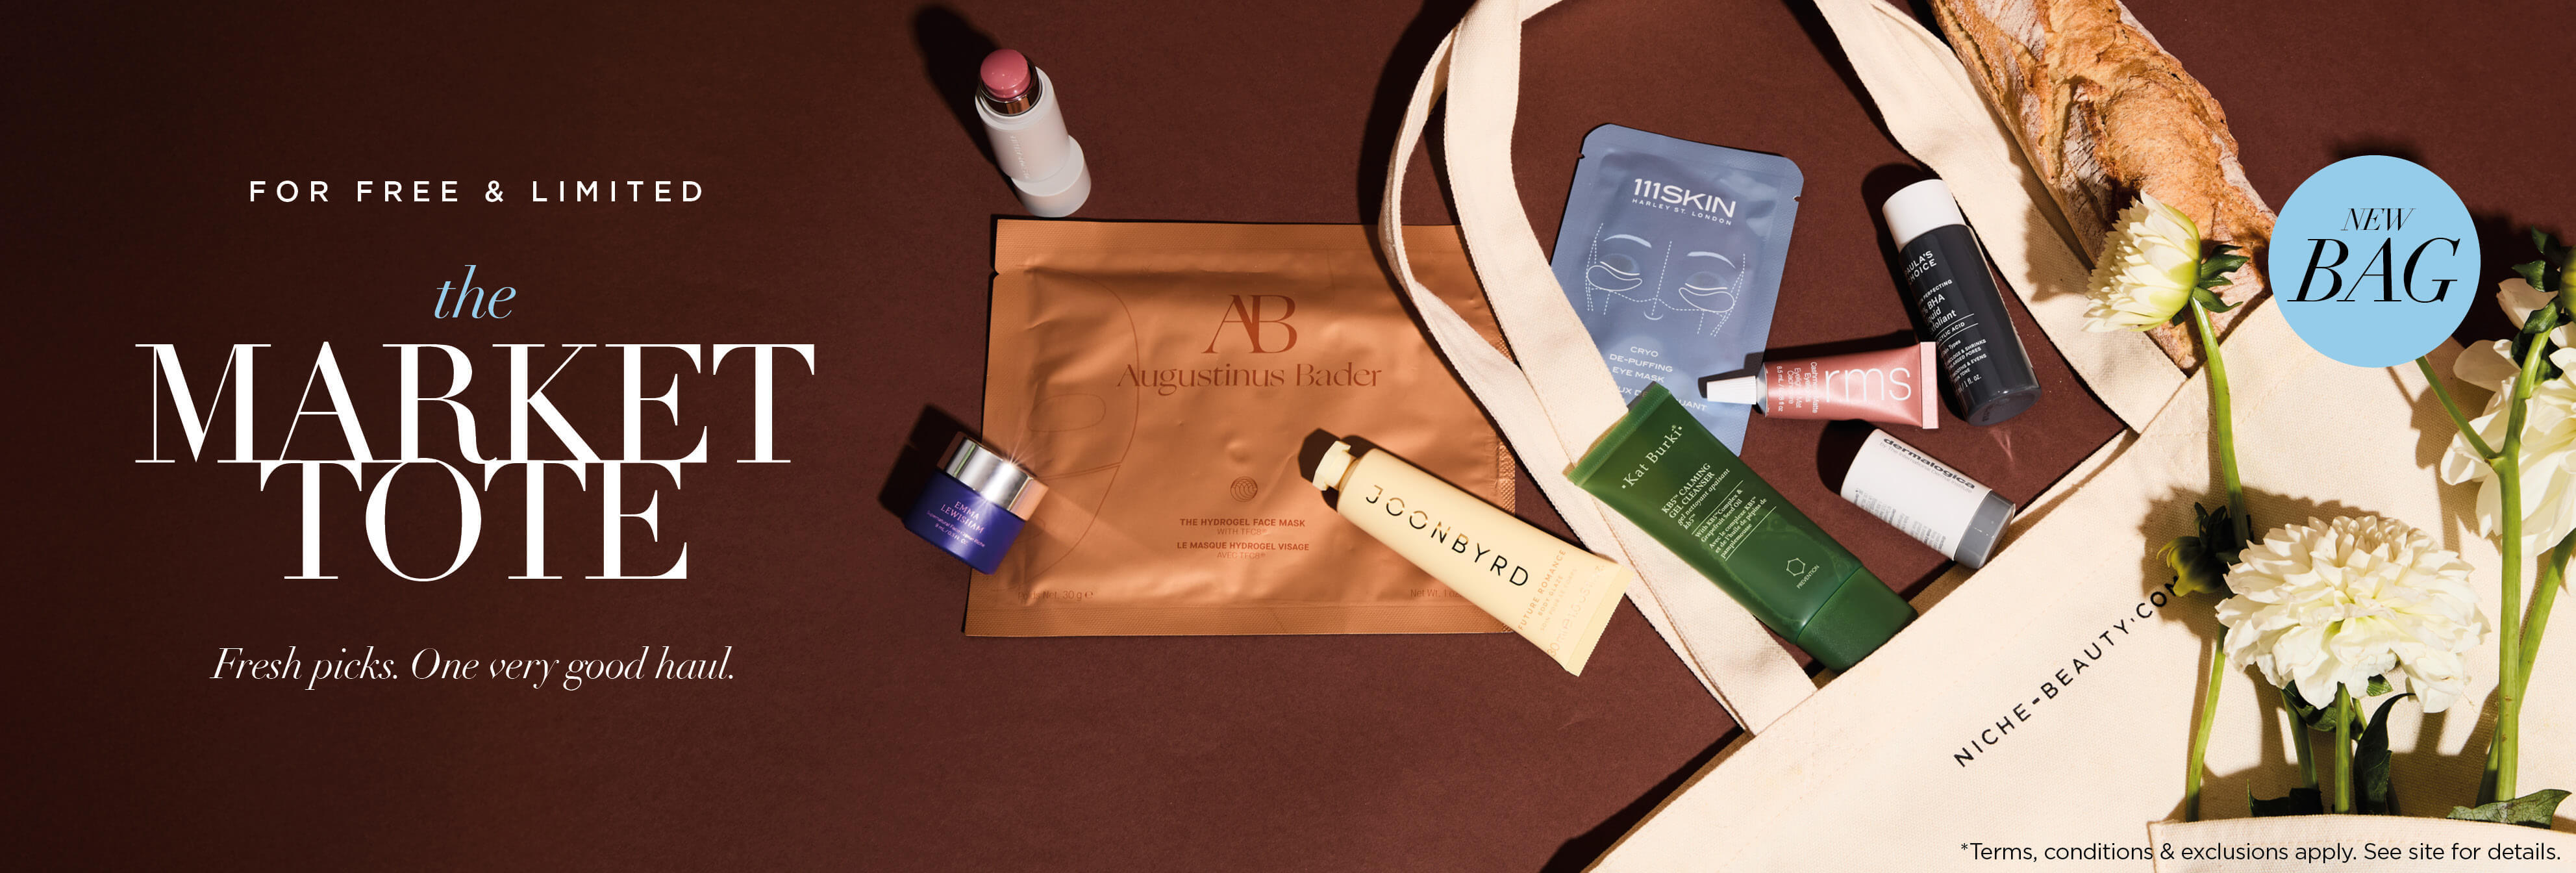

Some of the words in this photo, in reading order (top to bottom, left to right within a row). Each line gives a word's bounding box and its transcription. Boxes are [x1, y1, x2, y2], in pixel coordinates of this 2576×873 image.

[1632, 177, 1735, 217] 111SKIN
[1632, 198, 1669, 210] HARLEY
[1691, 212, 1731, 224] LONDON
[1923, 279, 1952, 299] PERFECTING
[1927, 293, 1944, 309] BHA
[1201, 294, 1298, 355] AB
[1929, 309, 1956, 333] xfoliant
[1952, 322, 1965, 331] ACID
[1630, 346, 1658, 357] CRYO
[1949, 340, 1960, 349] Types
[1964, 338, 1986, 351] SHRINKS
[1966, 346, 1981, 357] PORES
[1610, 353, 1673, 372] DE-PUFFING
[1971, 353, 1987, 363] EVENS
[1116, 362, 1285, 396] Augustinus
[1296, 361, 1382, 387] Bader
[1612, 367, 1632, 375] EYE
[1634, 372, 1664, 383] MASK
[1960, 368, 1970, 376] TONE
[1825, 367, 1912, 403] rms
[1883, 438, 1974, 488] dermalogica
[1678, 462, 1710, 496] CALMING
[1668, 503, 1683, 518] GEL
[1681, 471, 1714, 505] CLEANSER
[1676, 514, 1688, 525] gel
[1685, 490, 1708, 516] nettoyant
[1707, 468, 1730, 493] apaisant
[940, 504, 984, 533] LEWISHAM
[955, 501, 979, 519] EMMA
[1700, 517, 1725, 543] Grapefruit
[1722, 506, 1734, 519] Seed
[1732, 498, 1742, 508] Oil
[1718, 538, 1727, 547] de
[1759, 496, 1768, 505] de
[1179, 518, 1198, 526] THE
[1200, 518, 1250, 526] HYDROGEL
[1253, 518, 1276, 527] FACE
[1278, 518, 1306, 527] MASK
[1695, 524, 1708, 538] With
[1708, 535, 1721, 549] Avec
[1725, 509, 1745, 532] complexe
[1176, 541, 1187, 550] LE
[1189, 541, 1227, 550] MASQUE
[1229, 542, 1276, 550] HYDROGEL
[1277, 542, 1310, 551] VISAGE
[1366, 485, 1530, 588] JOONBYRD
[1719, 523, 1751, 558] pamplemousse
[1796, 564, 1818, 588] PREVENTION
[1062, 590, 1075, 599] 30
[1075, 591, 1082, 601] g
[1409, 588, 1425, 598] Net
[1517, 597, 1538, 630] FUTURE
[1537, 549, 1565, 594] ROMANCE
